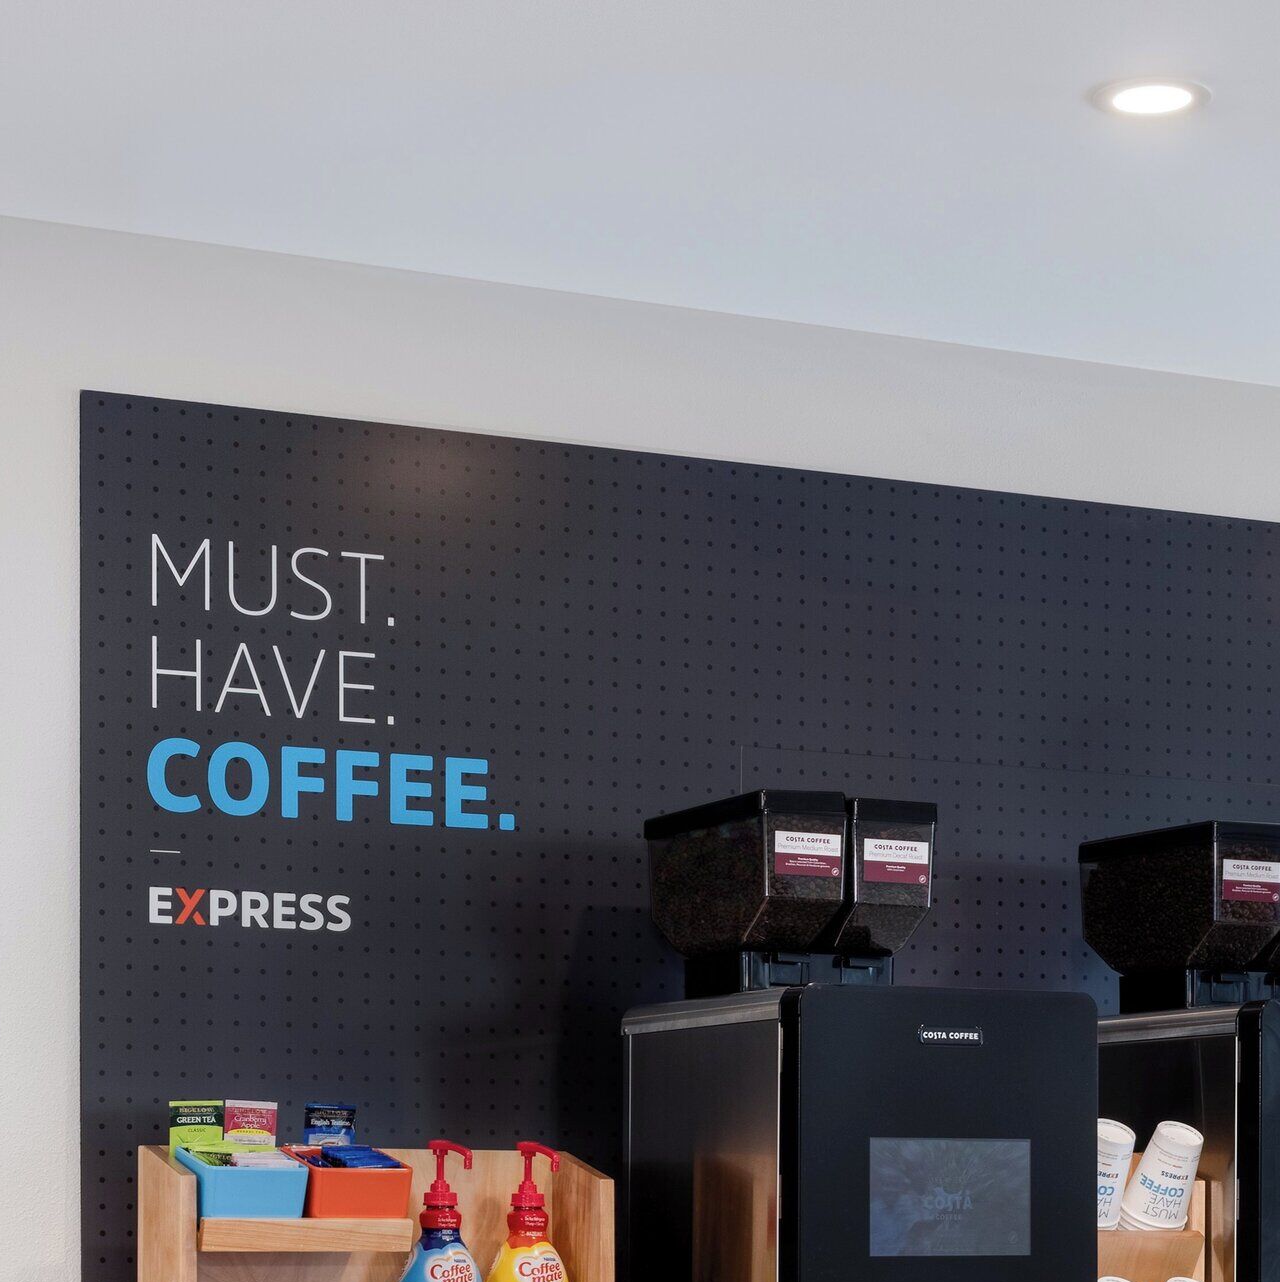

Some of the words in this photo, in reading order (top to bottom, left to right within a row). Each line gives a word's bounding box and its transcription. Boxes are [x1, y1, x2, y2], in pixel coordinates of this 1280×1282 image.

[151, 533, 395, 626] MUST.
[151, 635, 395, 725] HAVE.
[146, 737, 515, 831] COFFEE.
[148, 886, 352, 932] EXPRESS
[948, 1032, 979, 1040] COFFEE
[176, 1116, 201, 1124] GREEN
[234, 1115, 267, 1126] Cranberry
[240, 1122, 260, 1130] Apple
[1161, 1170, 1189, 1181] EXPRESS
[430, 1264, 471, 1280] Coffee
[518, 1262, 561, 1277] Coffee
